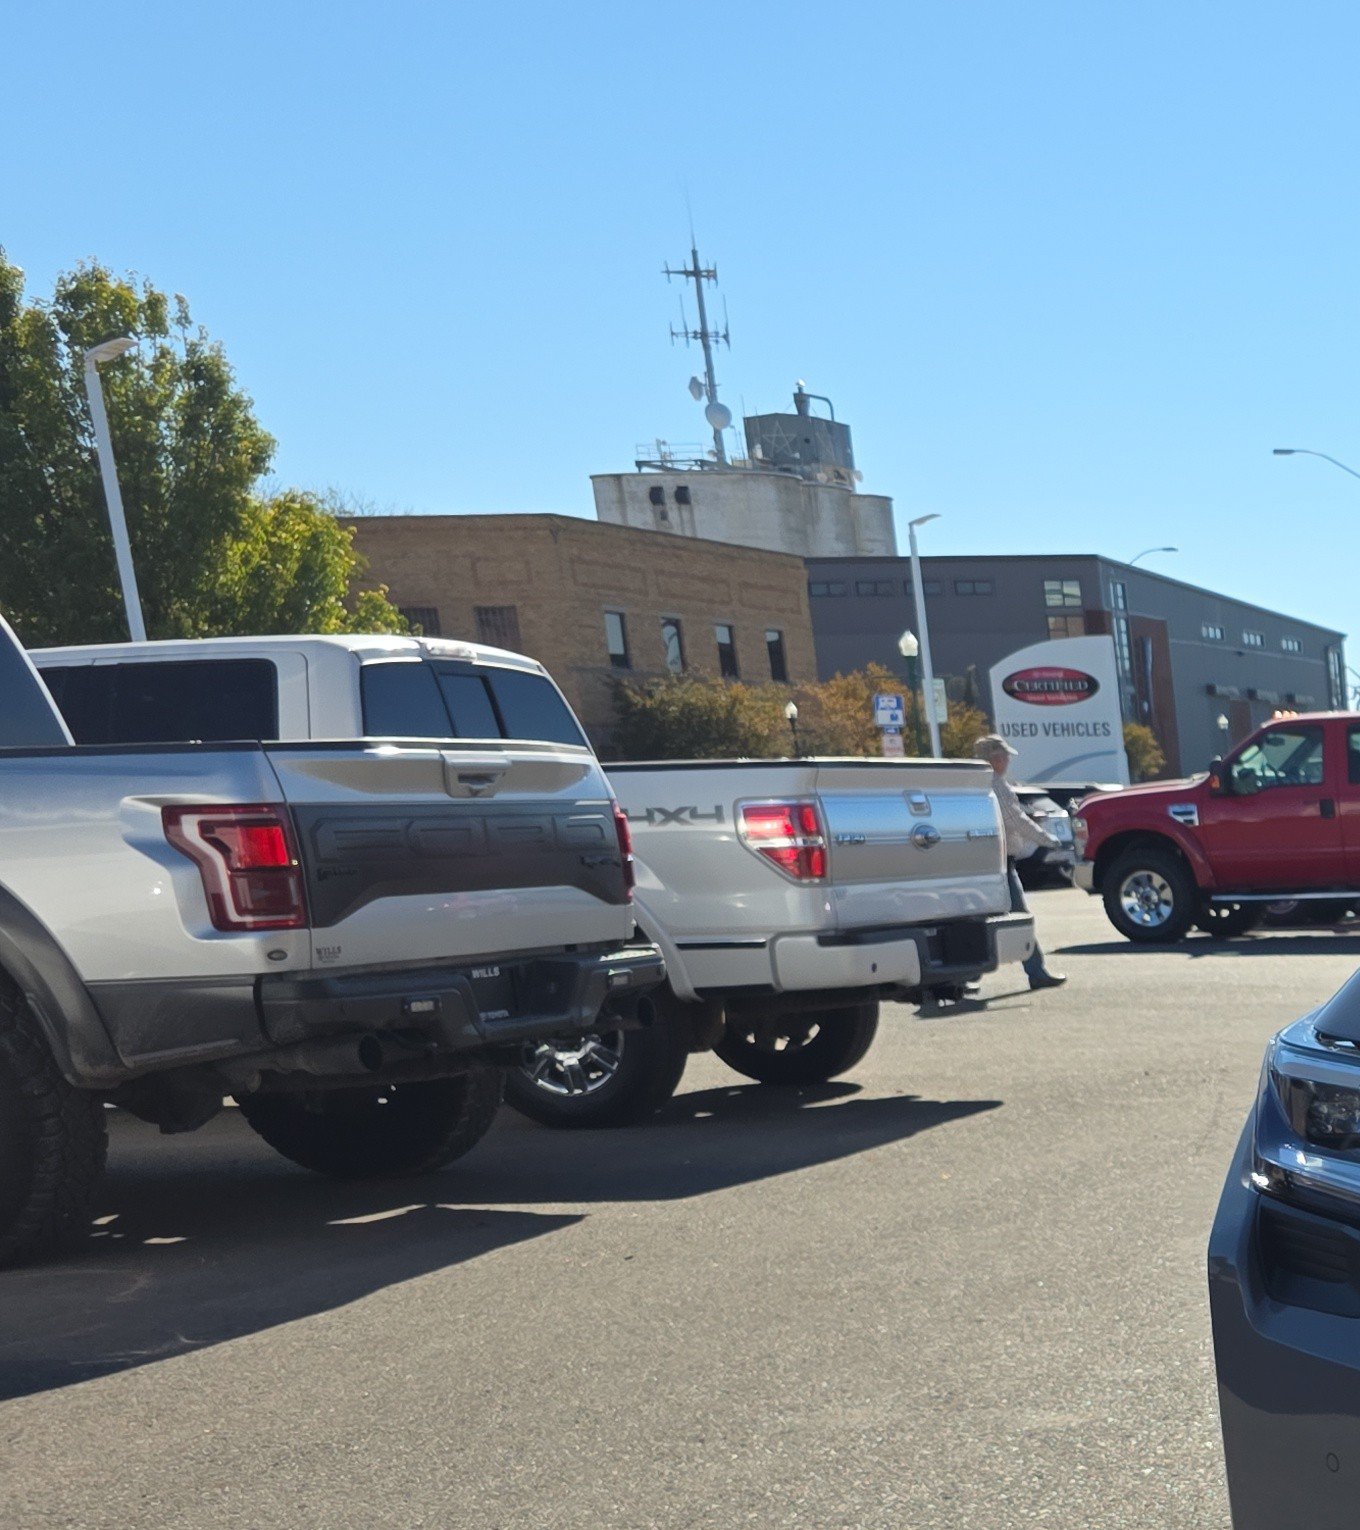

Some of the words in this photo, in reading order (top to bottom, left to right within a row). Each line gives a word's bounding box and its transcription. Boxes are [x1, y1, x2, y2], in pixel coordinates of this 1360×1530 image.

[1001, 721, 1039, 738] USED
[1041, 721, 1112, 738] VEHICLES
[471, 966, 501, 979] WILLS
